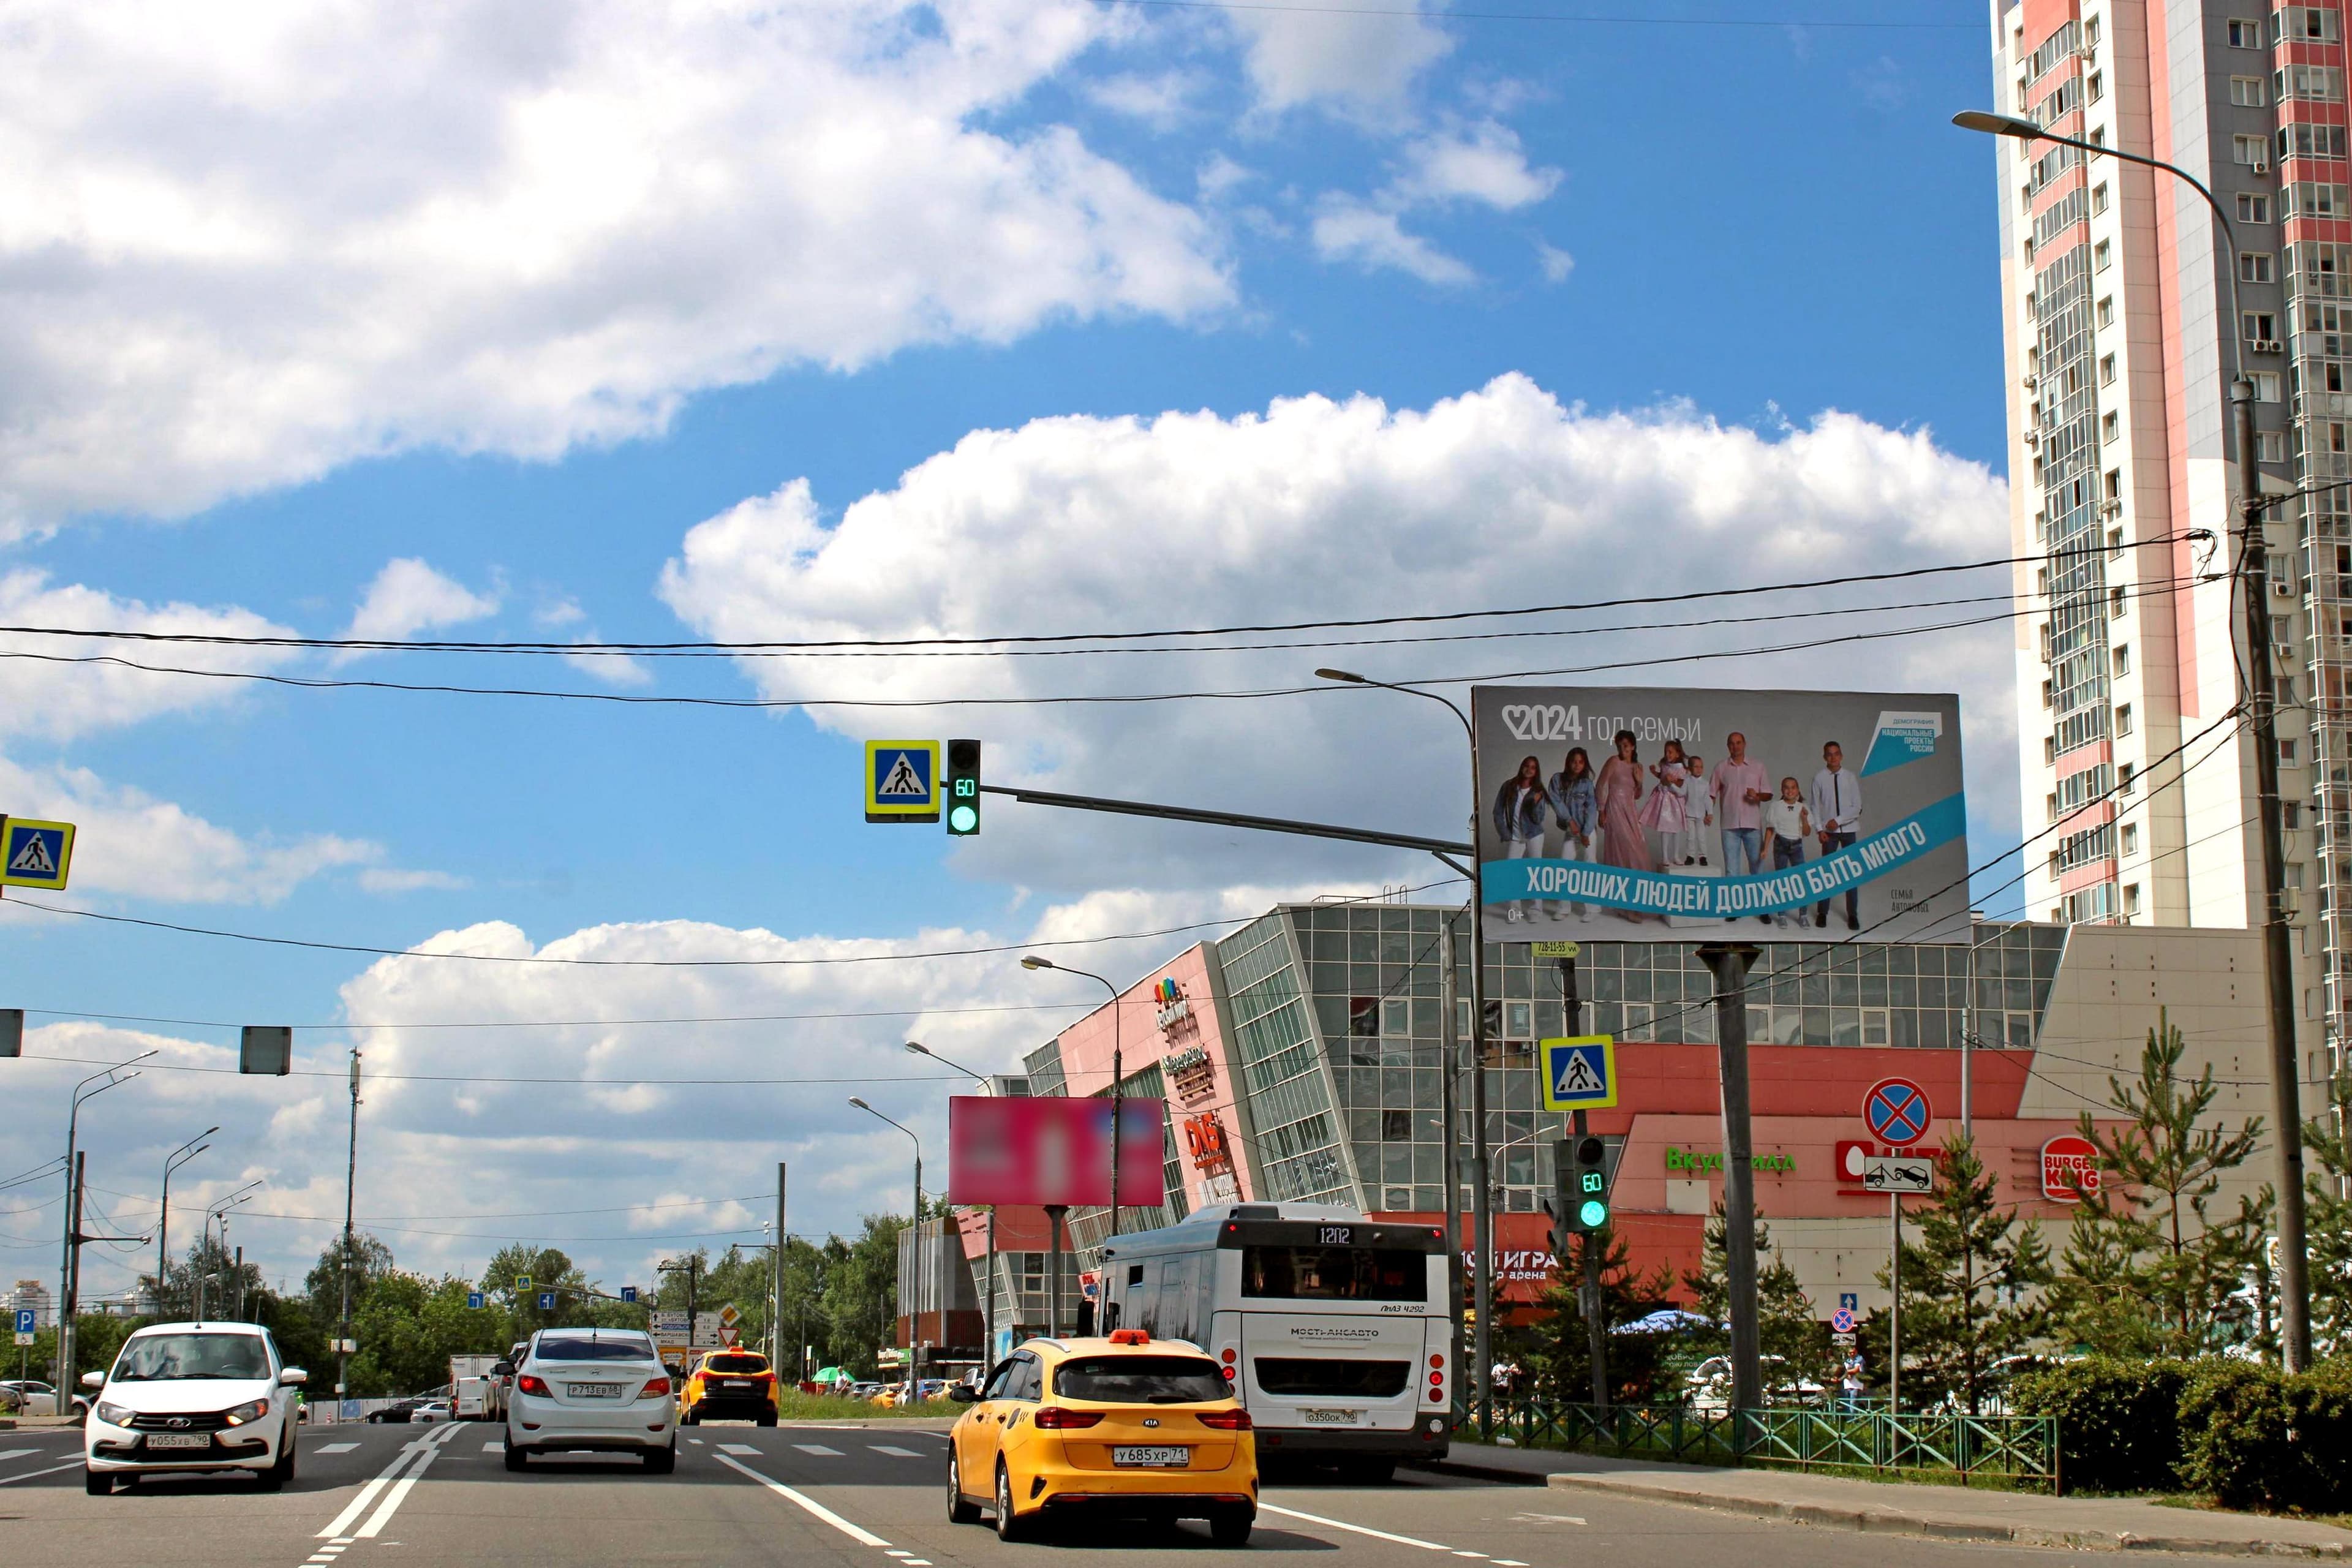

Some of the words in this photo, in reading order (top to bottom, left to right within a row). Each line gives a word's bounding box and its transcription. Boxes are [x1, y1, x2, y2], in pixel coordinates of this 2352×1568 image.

[1502, 704, 1582, 741] 2024
[956, 779, 974, 796] 60
[1526, 866, 1629, 902] ХОРОШИХ
[1633, 880, 1709, 913] ЛЮДЕЙ
[1716, 873, 1806, 913] ДОЛЖНО
[1806, 854, 1863, 895] БЫТЬ
[1859, 821, 1926, 871] МНОГО
[1891, 889, 1913, 900] СЕМЬЯ
[1508, 909, 1524, 921] 0+
[1184, 1113, 1219, 1156] DNS
[1666, 1147, 1797, 1175] Вкусилл
[2045, 1156, 2094, 1170] BURGE
[1583, 1174, 1602, 1192] 60
[1504, 1251, 1559, 1269] ИГРА
[1509, 1271, 1546, 1281] арена
